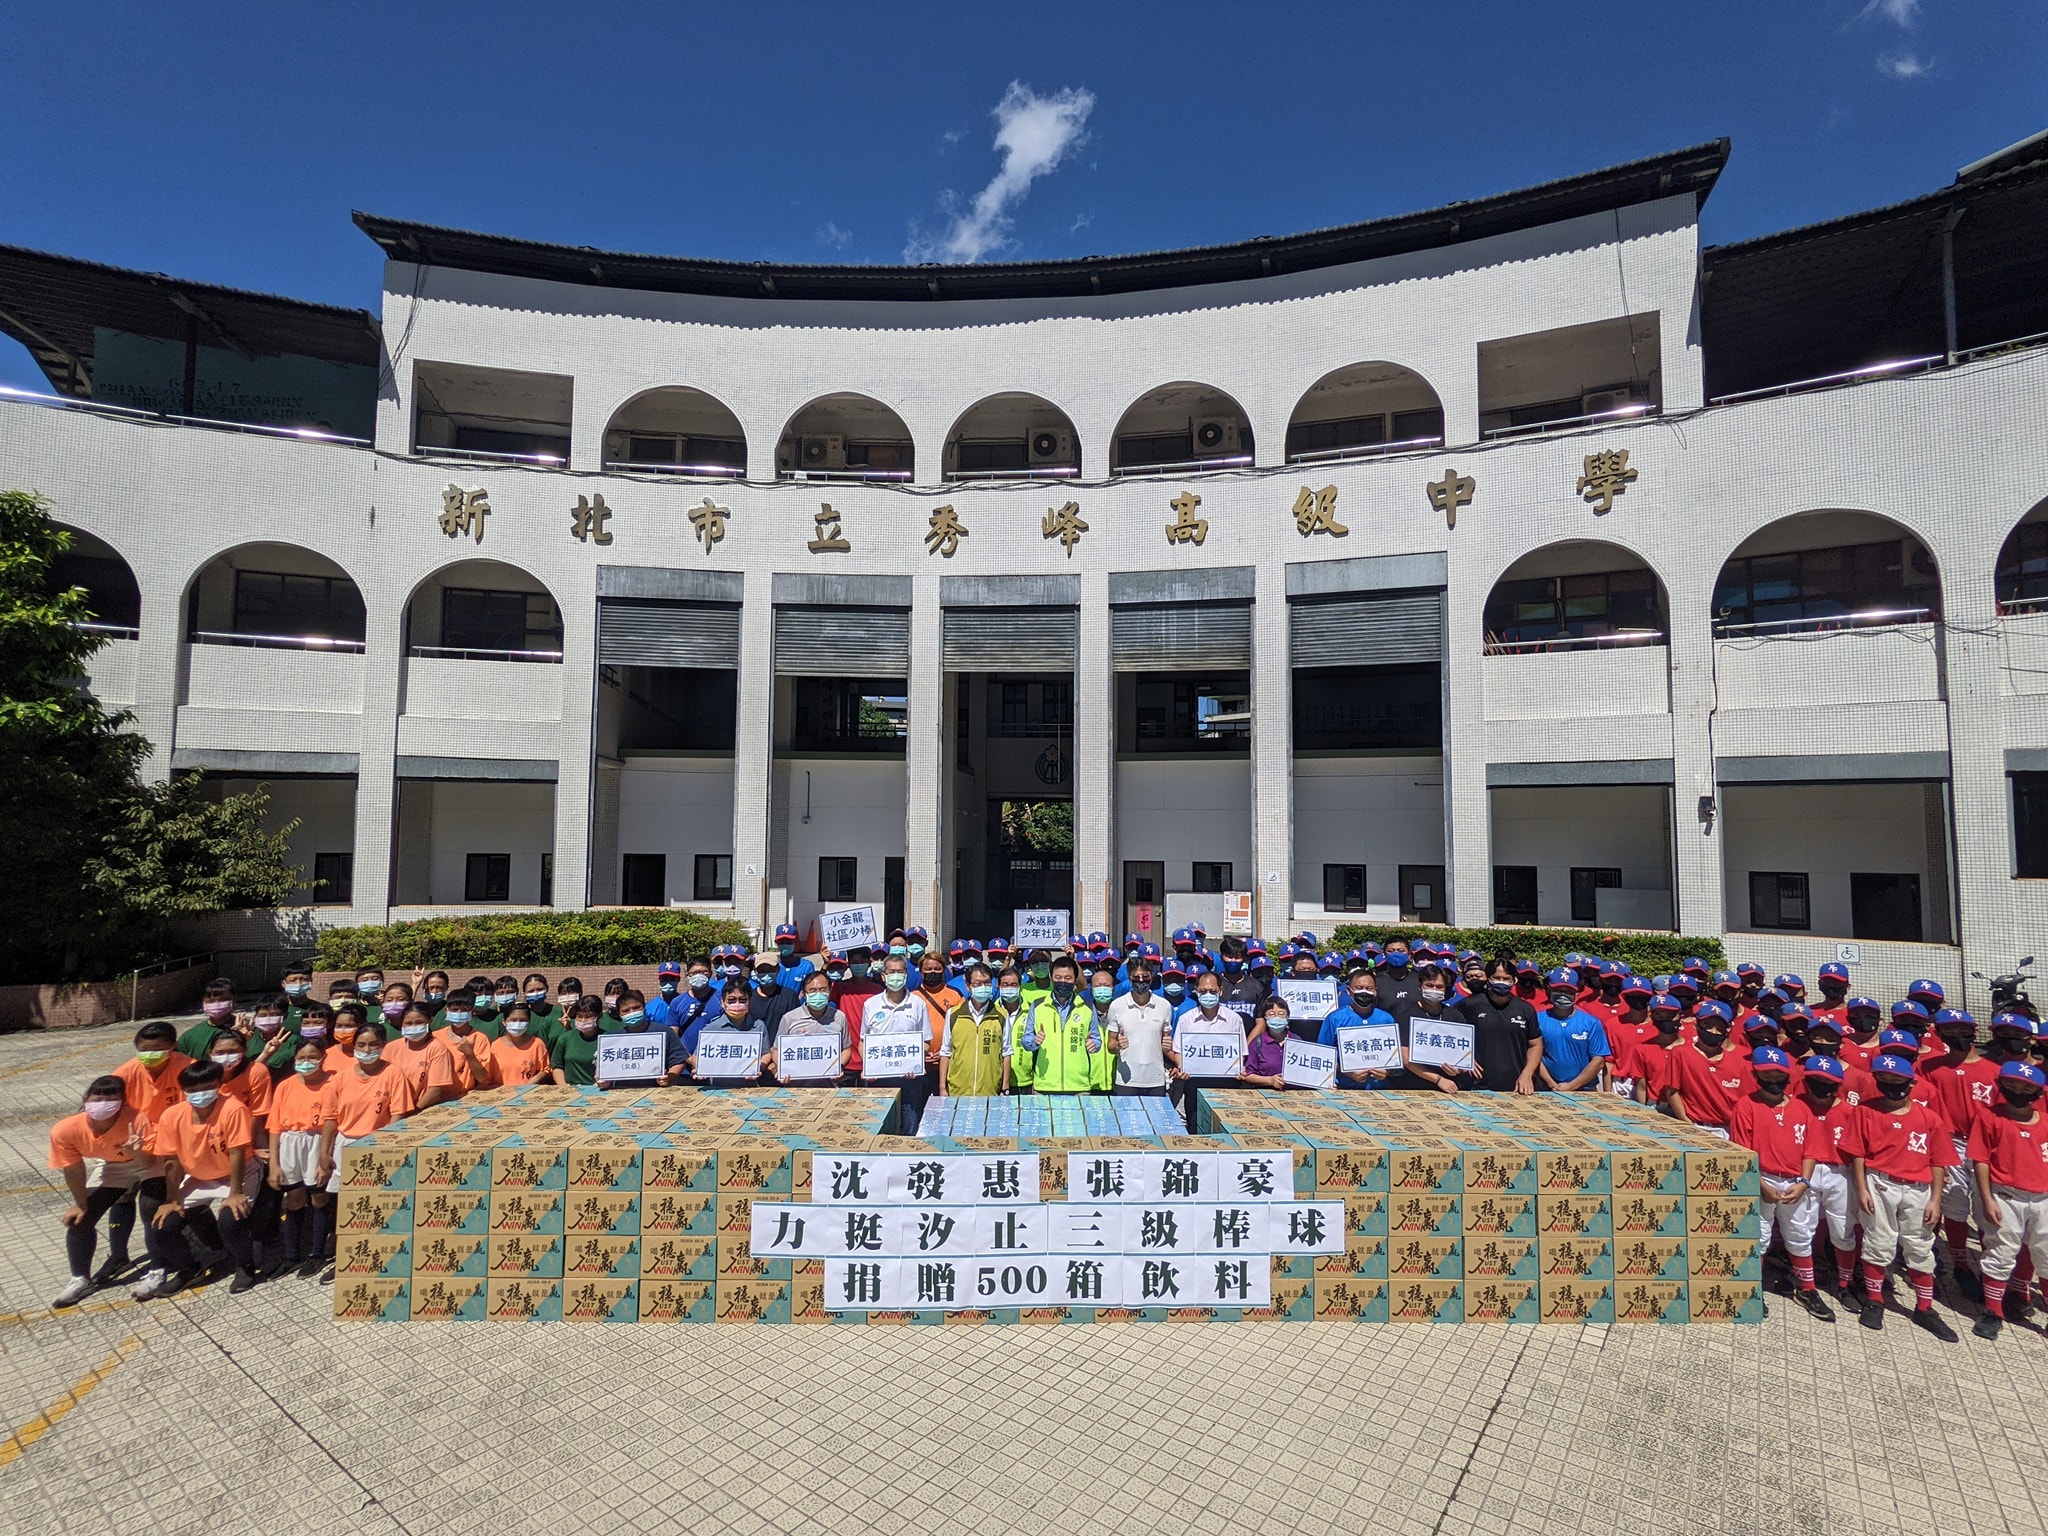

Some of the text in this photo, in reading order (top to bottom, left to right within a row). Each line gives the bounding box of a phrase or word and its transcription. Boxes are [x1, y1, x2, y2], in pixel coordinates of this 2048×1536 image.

[437, 448, 1639, 558] 新北市立秀峰高級中學
[830, 911, 865, 927] 小金龍
[826, 926, 871, 942] 社區少棒
[1021, 928, 1063, 939] 少年社區
[1343, 1037, 1396, 1054] 秀峰高中
[1415, 1031, 1470, 1051] 崇義高中
[602, 1046, 660, 1062] 秀峰國中
[701, 1044, 758, 1059] 北港國小
[783, 1046, 838, 1061] 金龍國小
[867, 1044, 920, 1060] 秀峰高中
[1184, 1045, 1238, 1059] 汐止國小
[1286, 1051, 1333, 1072] 汐止國中
[418, 1071, 426, 1083] 8
[520, 1069, 532, 1080] 16
[210, 1140, 226, 1154] 15
[830, 1160, 1021, 1200] 沈發惠
[1085, 1157, 1274, 1198] 張錦豪
[772, 1208, 1327, 1251] 力挺汐止三級棒球
[843, 1259, 1252, 1304] 捐贈500箱飲料
